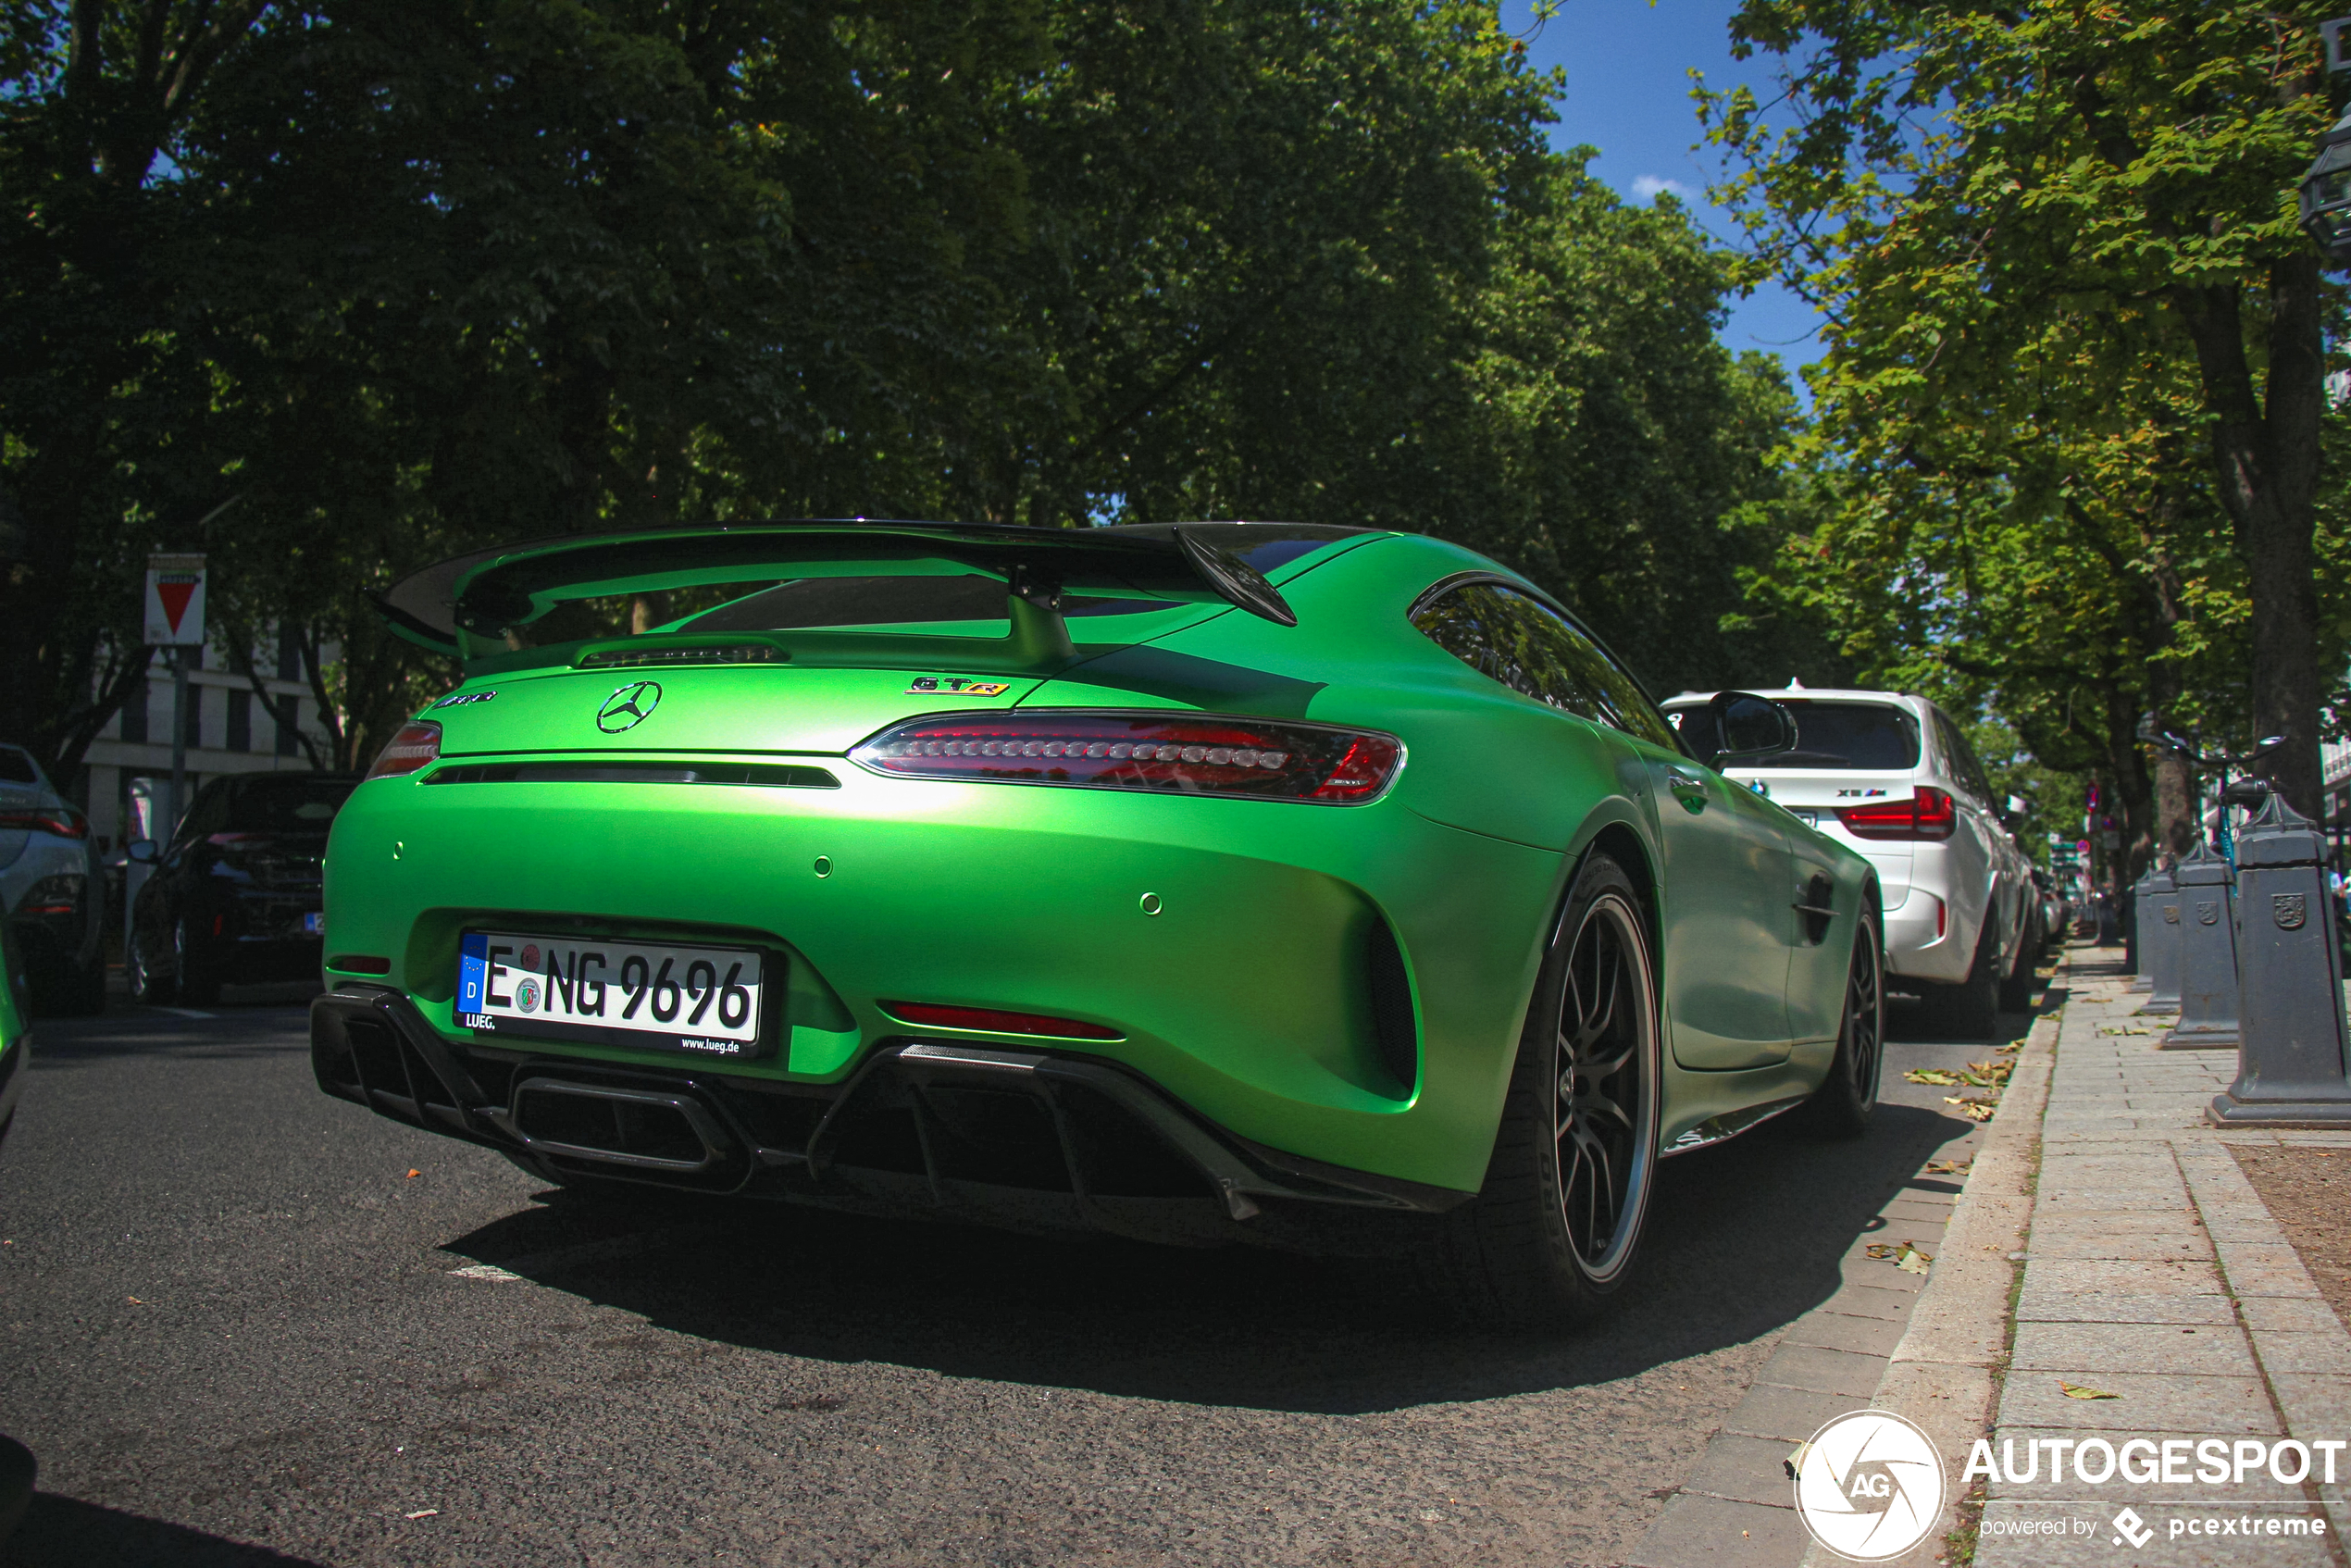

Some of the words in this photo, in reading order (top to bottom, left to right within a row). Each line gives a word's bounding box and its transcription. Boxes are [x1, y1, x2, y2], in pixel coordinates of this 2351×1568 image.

[466, 982, 477, 1000] D
[486, 945, 514, 1008] E
[544, 950, 606, 1017] NG
[620, 955, 751, 1029] 9696
[466, 1014, 496, 1030] LUEG.
[681, 1038, 740, 1054] www.lueg.de
